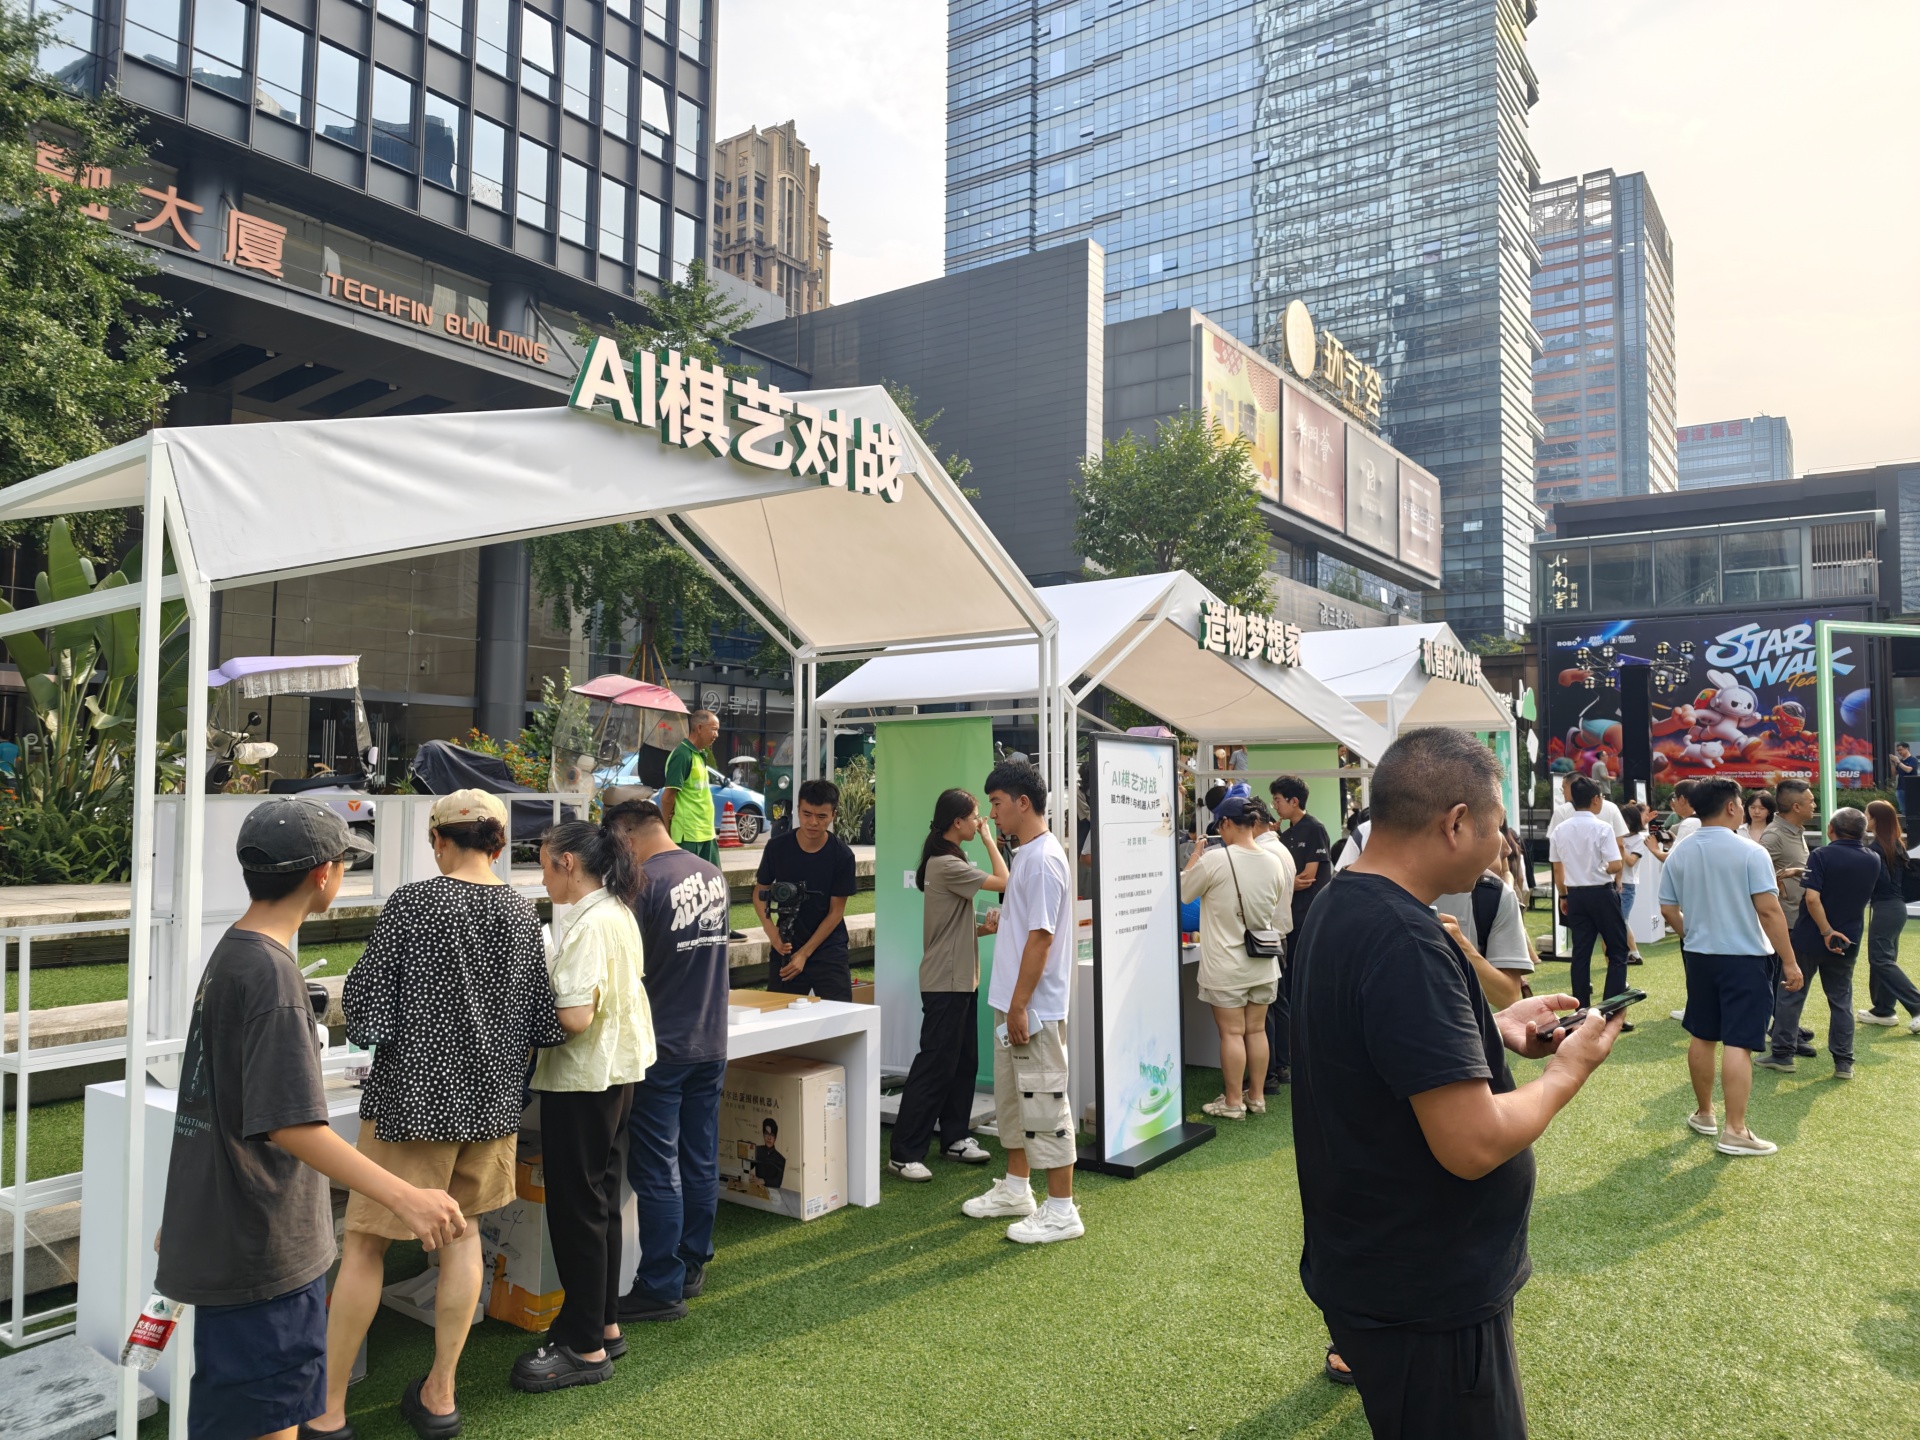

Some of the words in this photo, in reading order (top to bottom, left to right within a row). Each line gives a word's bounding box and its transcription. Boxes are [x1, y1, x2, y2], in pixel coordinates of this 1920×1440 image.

[326, 271, 434, 326] TECHFIN
[444, 312, 549, 365] BUILDING
[570, 335, 904, 503] AI棋艺对战
[1201, 599, 1302, 668] 造物梦想家
[1705, 622, 1816, 668] STAR
[1421, 639, 1482, 687] 机智的小伙伴
[1786, 671, 1835, 693] Tea
[1111, 769, 1158, 795] AI棋艺对战
[1781, 770, 1813, 778] ROBO
[1834, 770, 1860, 778] AGUS
[670, 872, 706, 910] FISH
